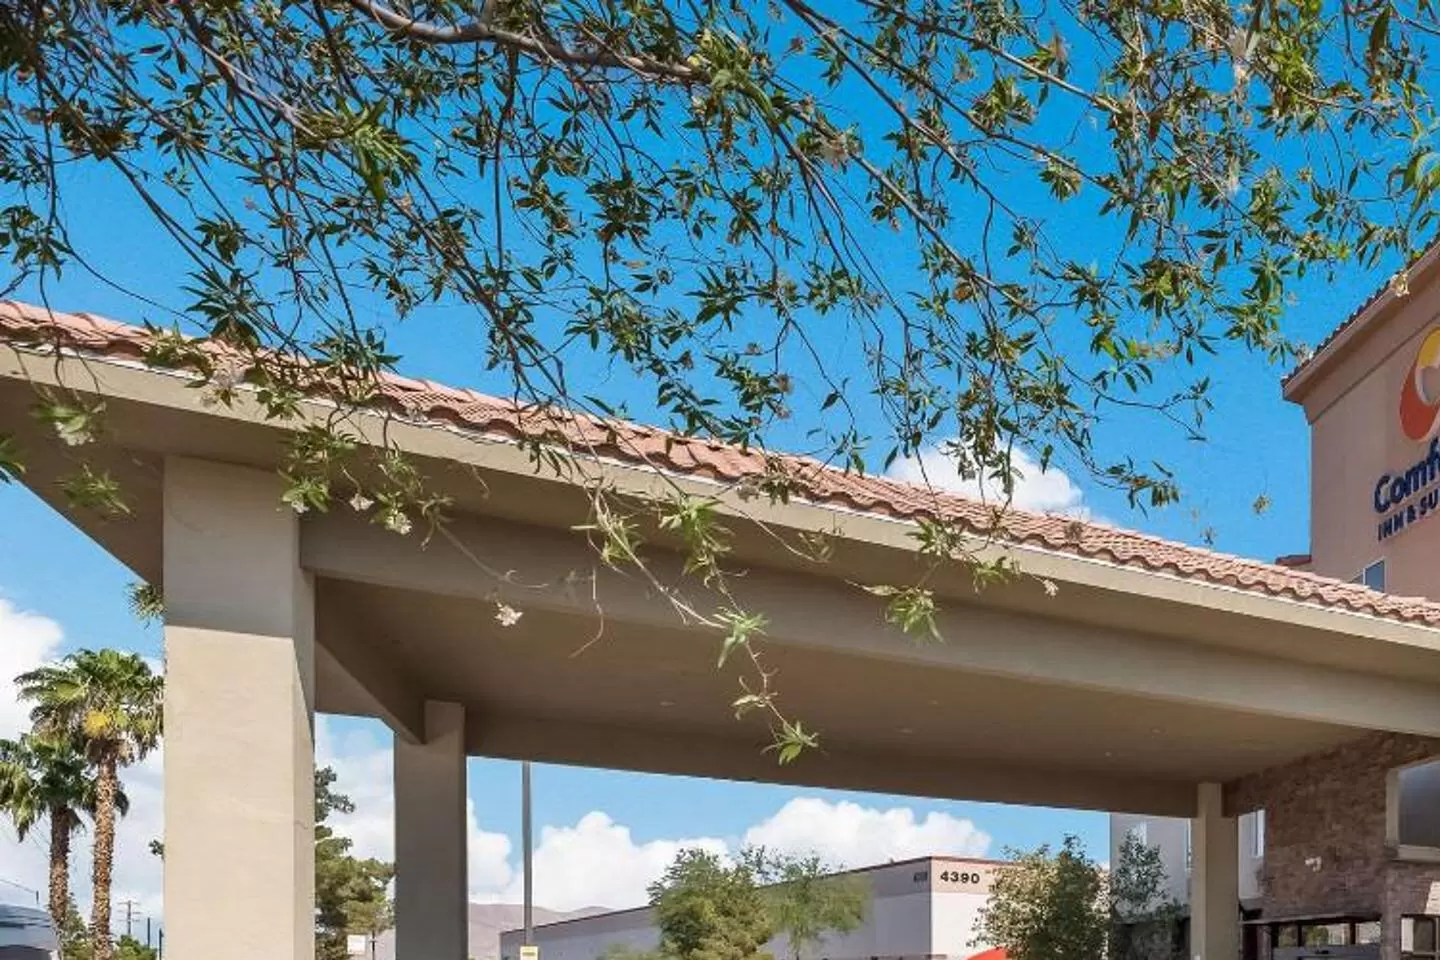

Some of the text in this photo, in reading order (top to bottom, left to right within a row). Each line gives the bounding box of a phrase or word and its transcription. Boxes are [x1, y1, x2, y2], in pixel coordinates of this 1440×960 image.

[1378, 508, 1404, 541] INN
[1407, 504, 1417, 524] &
[940, 870, 981, 884] 4390
